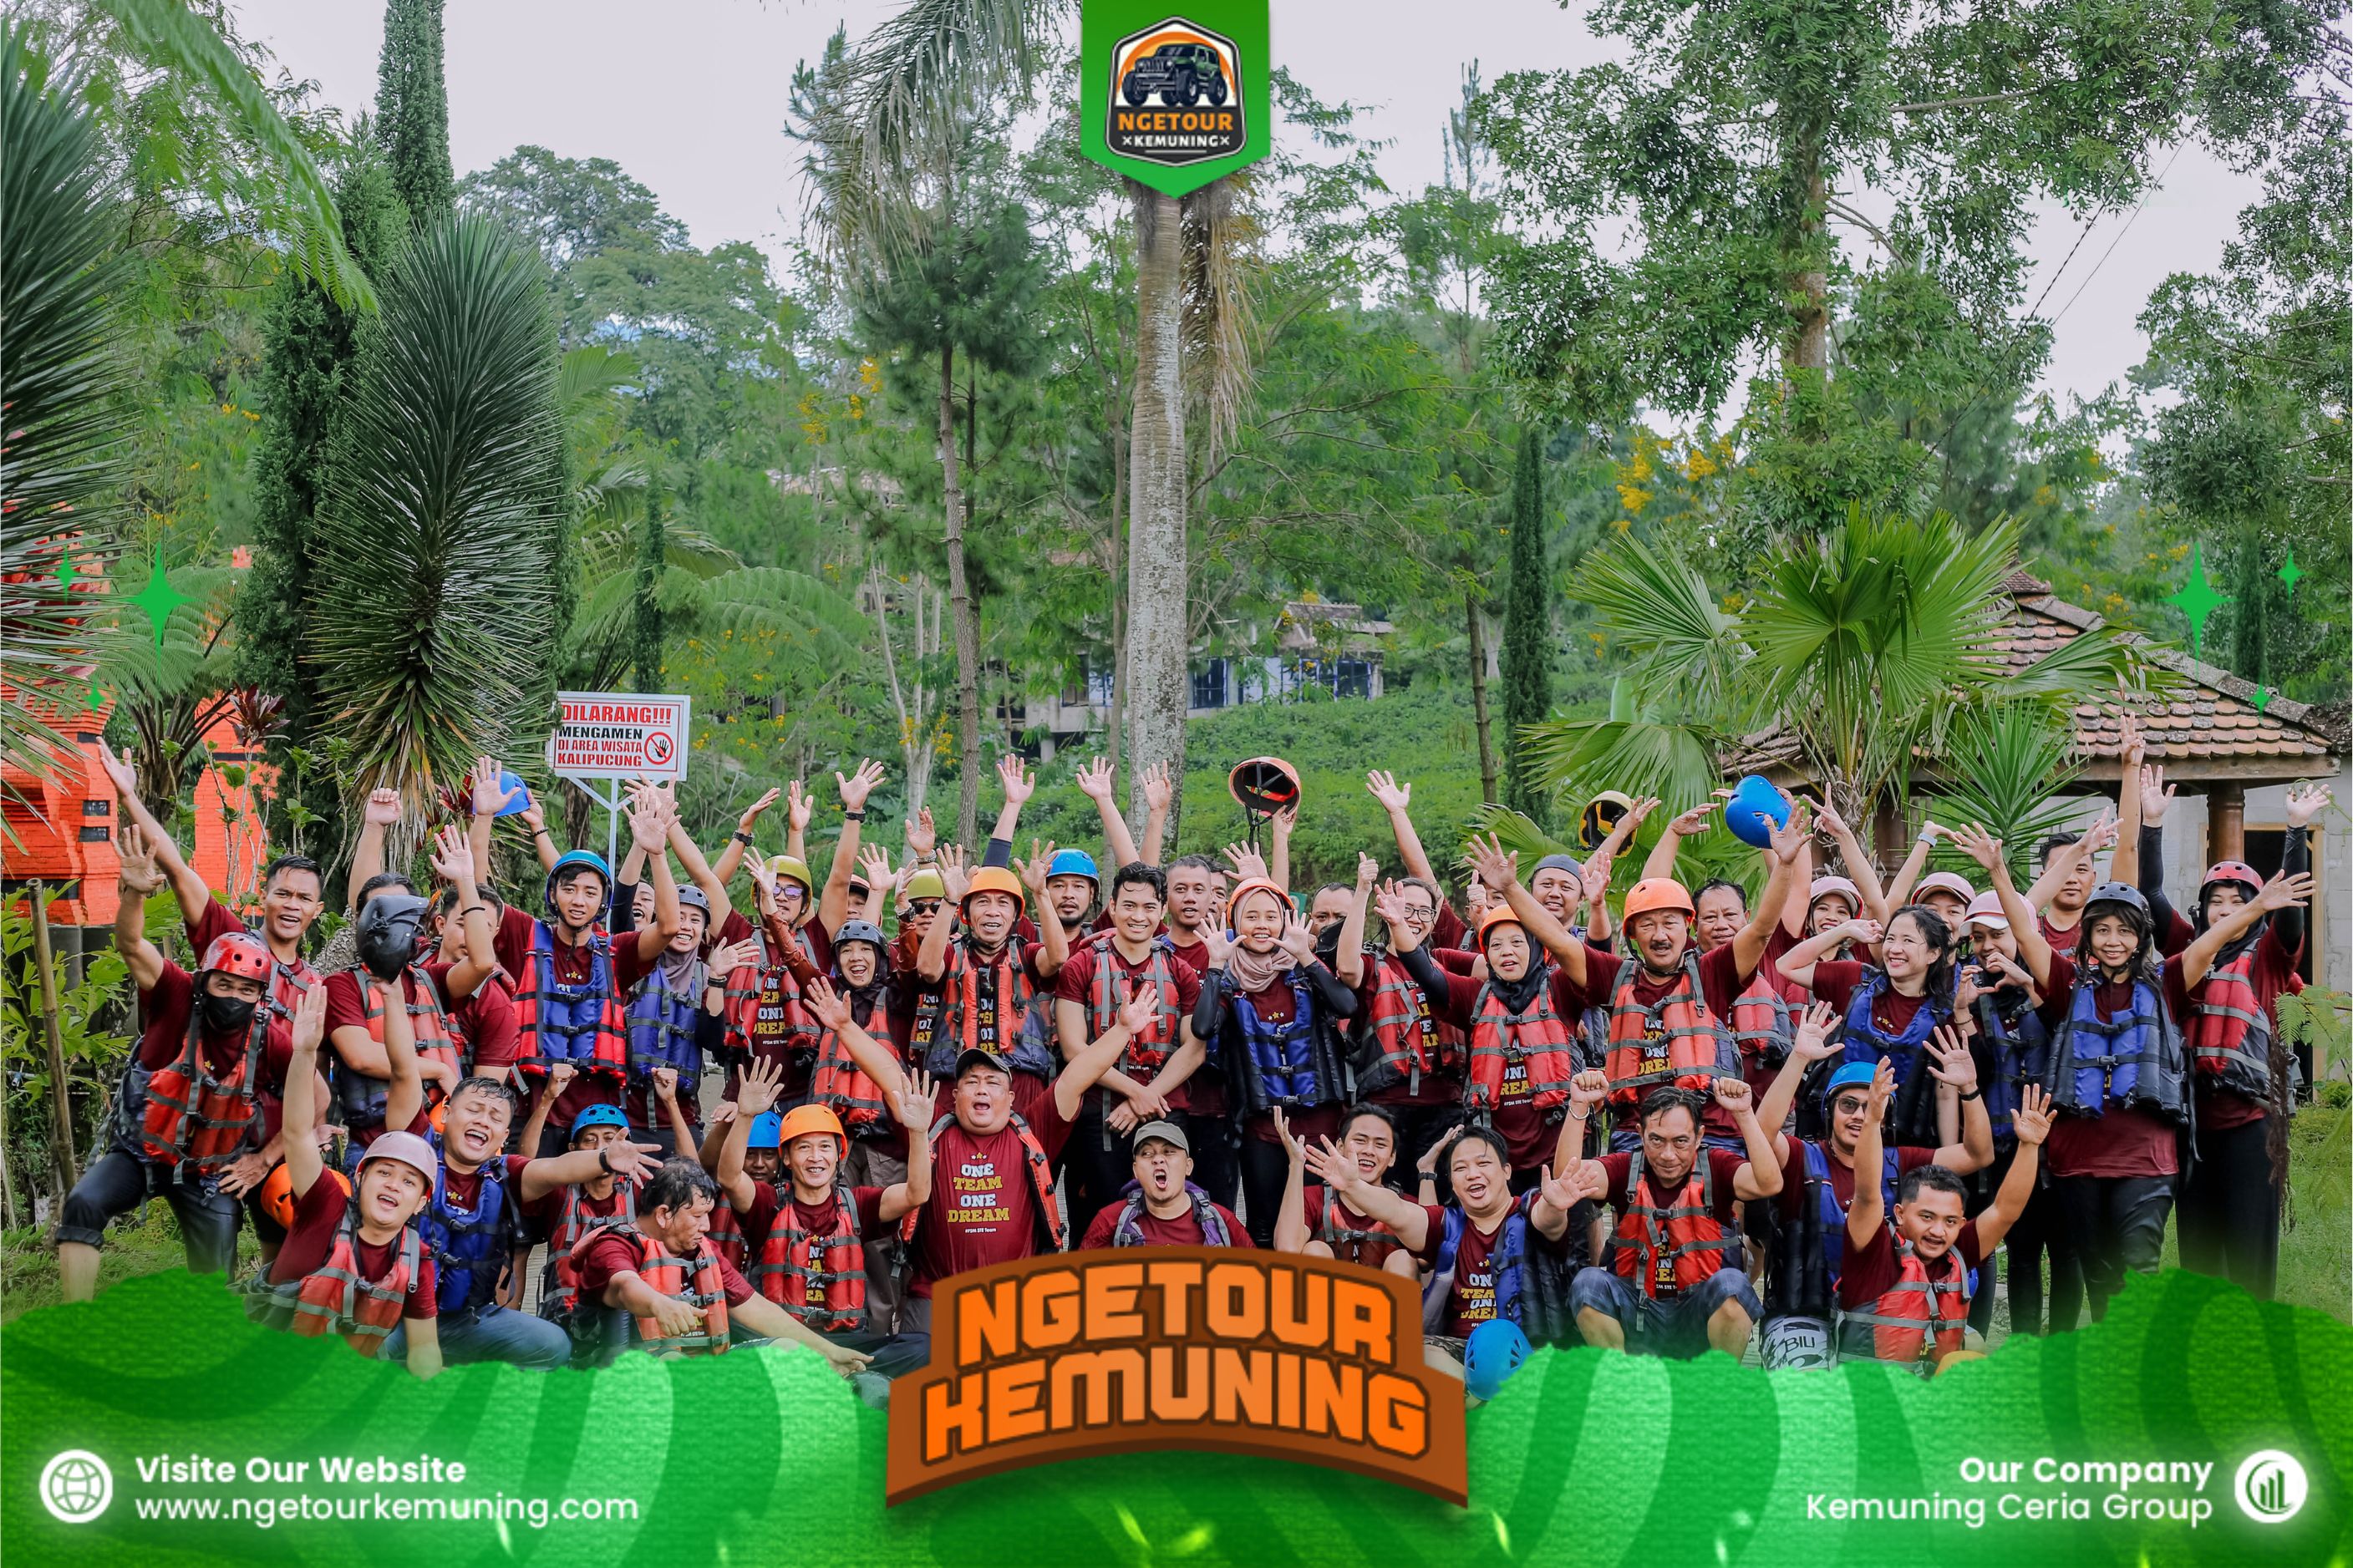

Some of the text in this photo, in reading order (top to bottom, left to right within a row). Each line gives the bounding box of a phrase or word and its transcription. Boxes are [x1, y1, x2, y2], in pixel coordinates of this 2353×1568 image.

[562, 704, 671, 723] DILARANG!!!
[558, 726, 643, 739] MENGAMEN
[558, 739, 642, 753] DI AREA WISATA
[557, 753, 642, 766] KALIPUCUNG
[961, 1163, 994, 1177] ONE
[953, 1175, 1003, 1191] TEAM
[960, 1194, 997, 1207] ONE
[948, 1208, 1010, 1222] DREAM
[1469, 1273, 1492, 1286] ON
[1461, 1287, 1496, 1299] TEA
